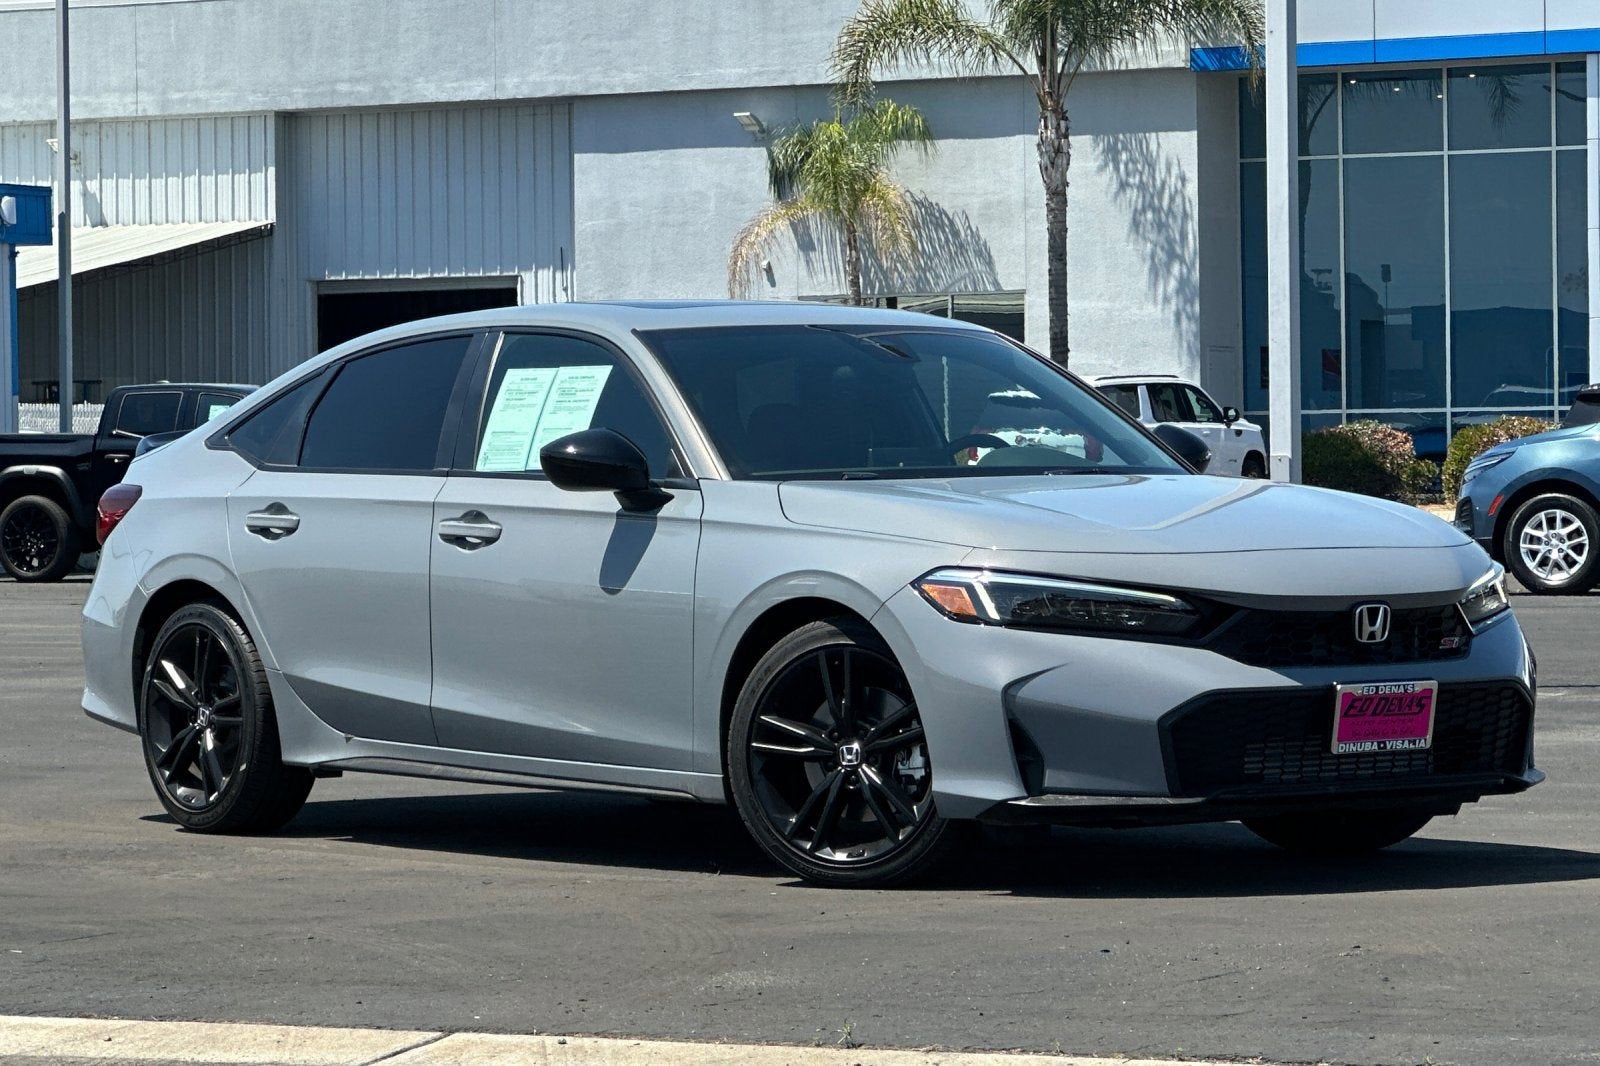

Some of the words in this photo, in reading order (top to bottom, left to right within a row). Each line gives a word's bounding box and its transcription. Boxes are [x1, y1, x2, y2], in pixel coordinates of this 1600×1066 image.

[1363, 686, 1376, 695] ED
[1378, 684, 1414, 694] DENA'S
[1341, 697, 1374, 717] ED
[1338, 742, 1378, 752] DINUBA
